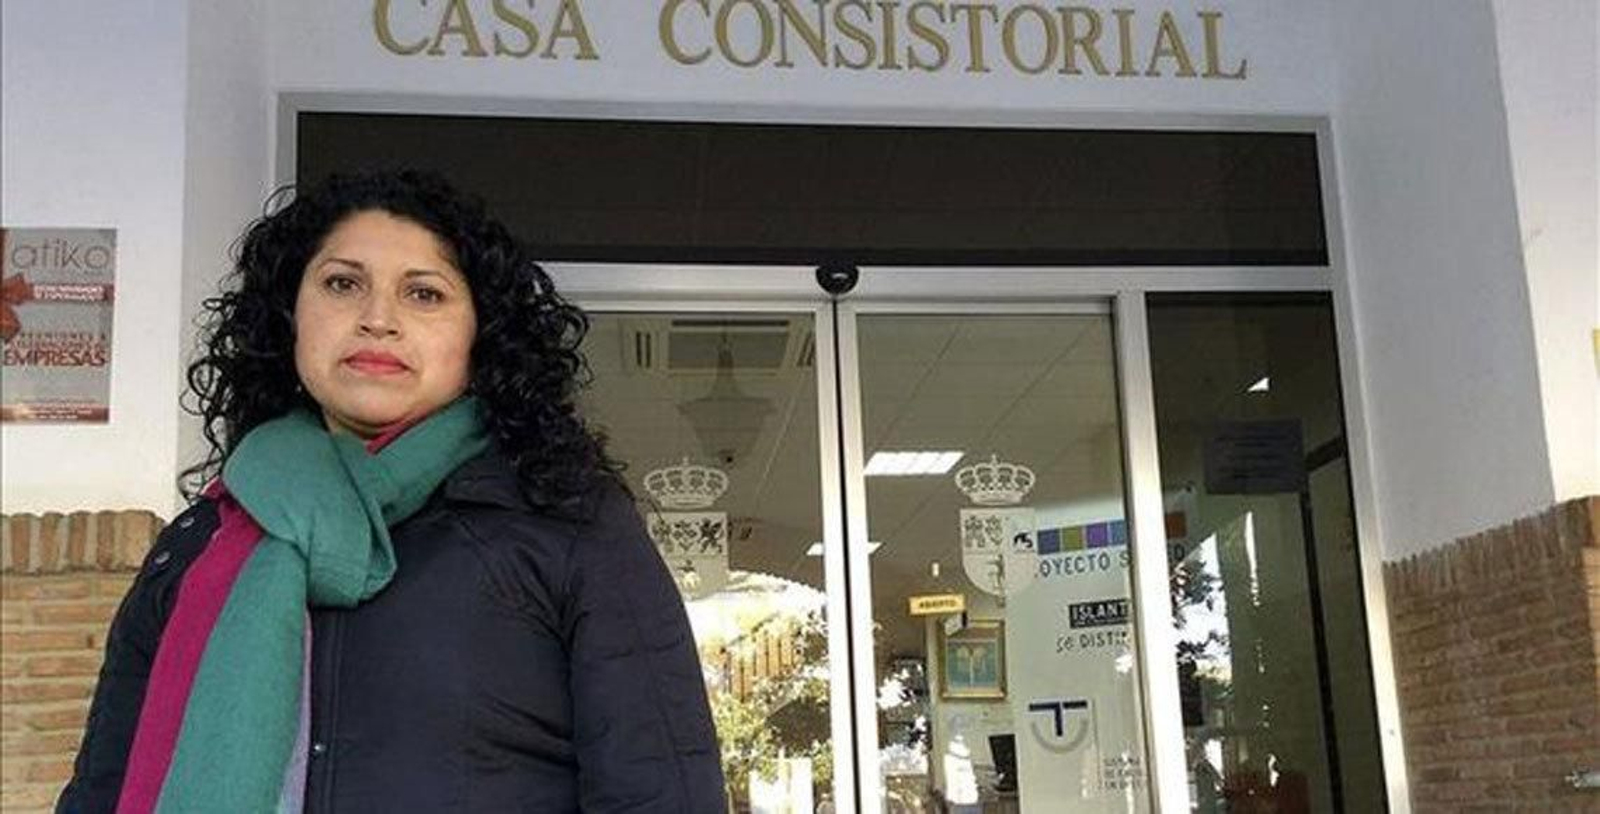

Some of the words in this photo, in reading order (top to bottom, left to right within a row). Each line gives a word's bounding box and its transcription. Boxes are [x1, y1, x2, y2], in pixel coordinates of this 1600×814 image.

[374, 0, 599, 60] CASA
[658, 0, 1247, 80] CONSISTORIAL
[11, 238, 110, 270] atiko
[3, 349, 106, 366] EMPRESAS
[1034, 552, 1111, 578] OYECTO
[1072, 602, 1126, 620] ISLANT
